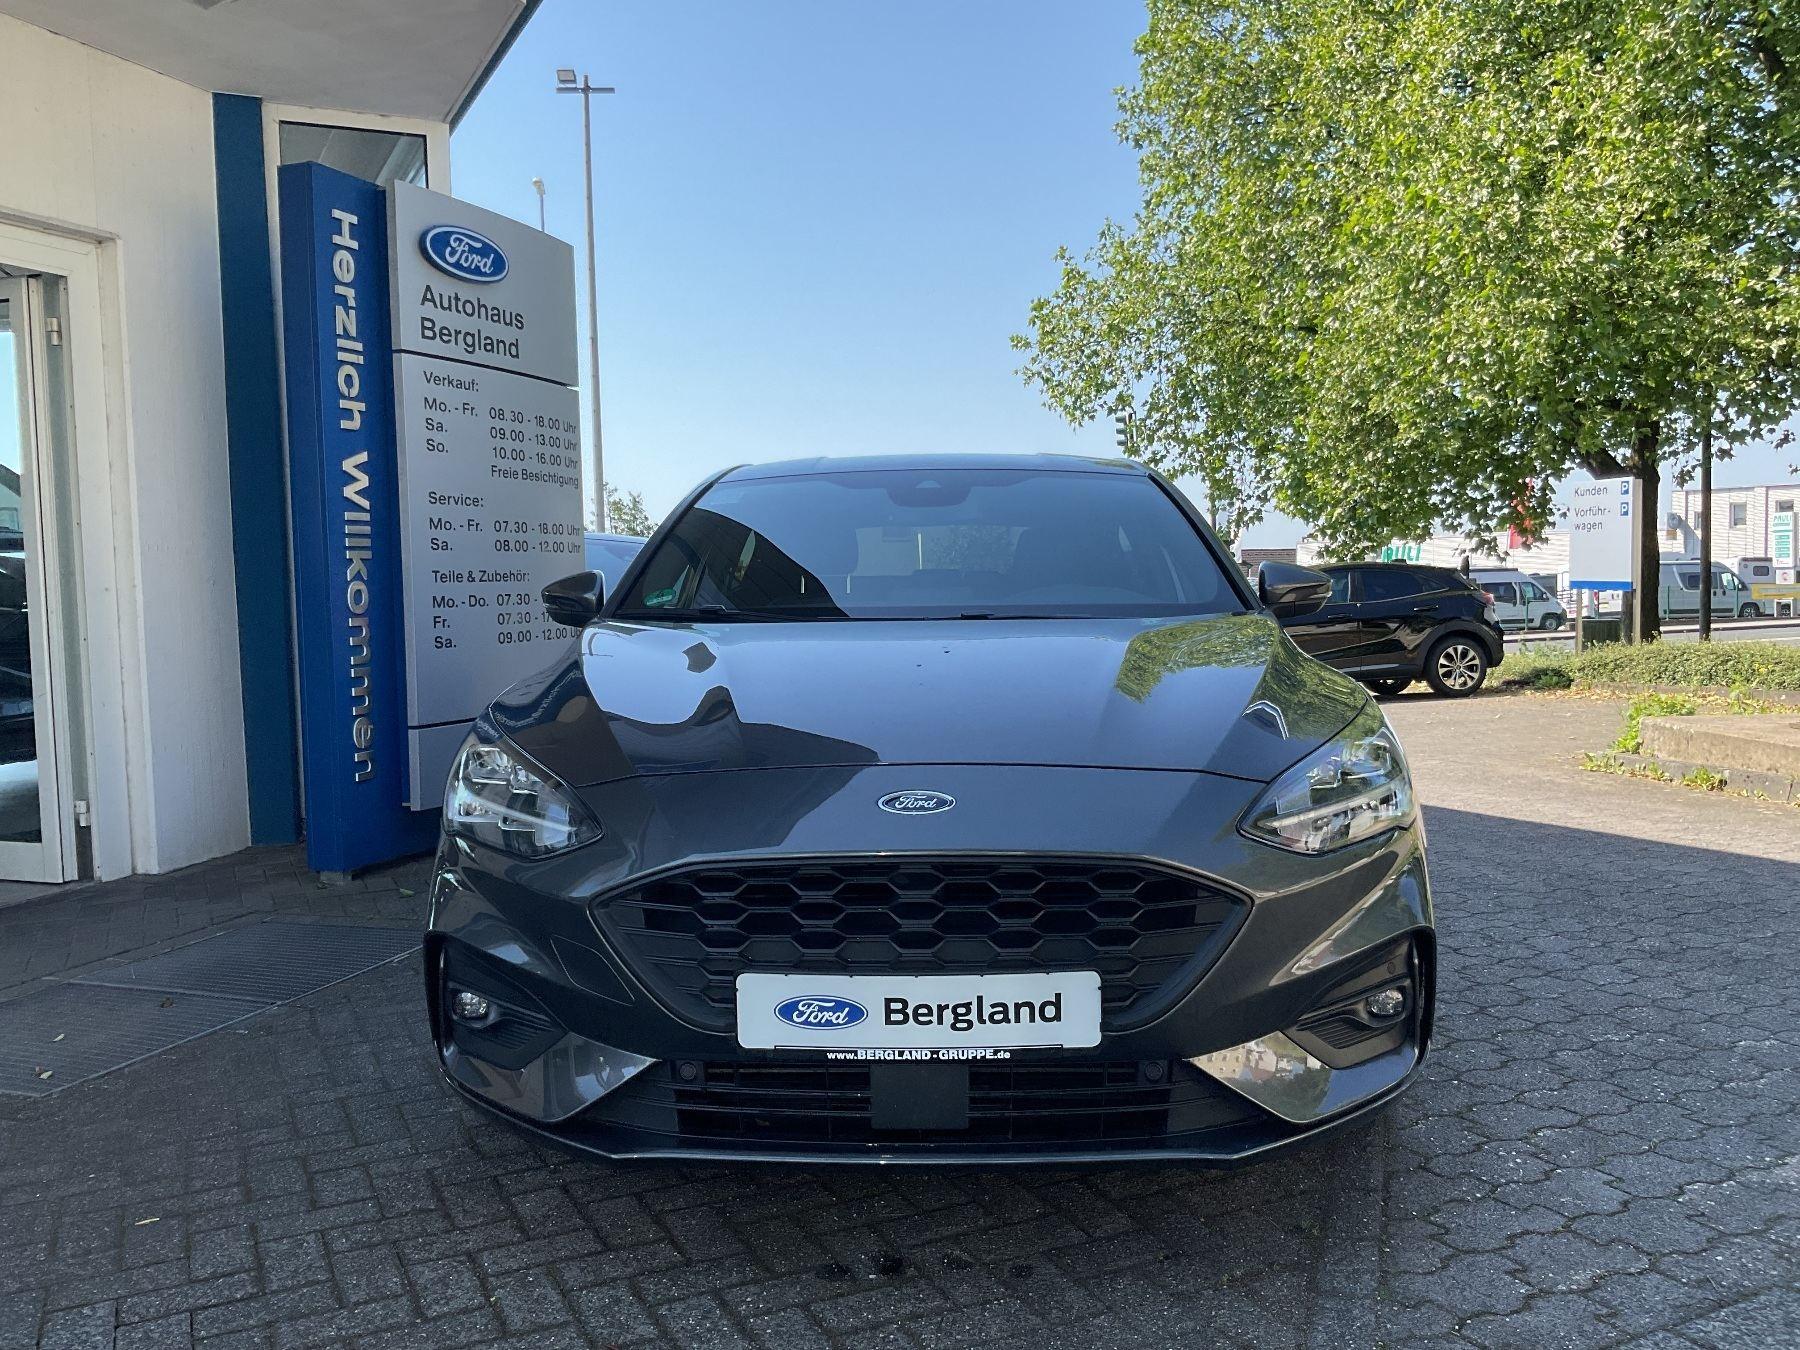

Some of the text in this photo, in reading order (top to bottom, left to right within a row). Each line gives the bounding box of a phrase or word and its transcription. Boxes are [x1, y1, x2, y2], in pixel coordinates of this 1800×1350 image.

[445, 232, 494, 275] Ford
[420, 284, 525, 330] Autohaus
[420, 317, 520, 360] Bergland
[423, 370, 479, 392] Verkauf:
[489, 406, 524, 424] 08.30
[534, 415, 560, 431] 18.00
[563, 420, 577, 434] Uhr
[425, 417, 448, 433] Sa.
[490, 426, 525, 443] 09.00
[535, 434, 561, 449] 13.00
[564, 439, 577, 452] Uhr
[426, 438, 449, 454] So.
[492, 446, 526, 462] 10.00
[536, 452, 562, 467] 16.00
[564, 457, 579, 470] Uhr
[491, 465, 579, 489] Freie Besichtigung
[332, 208, 377, 782] Herzlich Willkommen
[428, 491, 484, 508] Service:
[1574, 486, 1608, 497] Kunden
[1574, 506, 1611, 517] Vorführ-
[493, 520, 528, 534] 07.30
[538, 523, 564, 536] 18.00
[566, 524, 581, 537] Uhr
[1574, 521, 1603, 532] wagen
[430, 537, 453, 551] Sa.
[494, 539, 529, 552] 08.00
[539, 541, 565, 553] 12.00
[567, 542, 581, 554] Uhr
[432, 569, 530, 583] Teile & Zubehör:
[496, 593, 531, 606] 07.30
[433, 615, 451, 629] Fr.
[497, 611, 531, 626] 07.30
[434, 635, 457, 649] Sa.
[497, 630, 532, 645] 09.00
[542, 627, 568, 641] 12.00
[883, 992, 1062, 1032] Bergland
